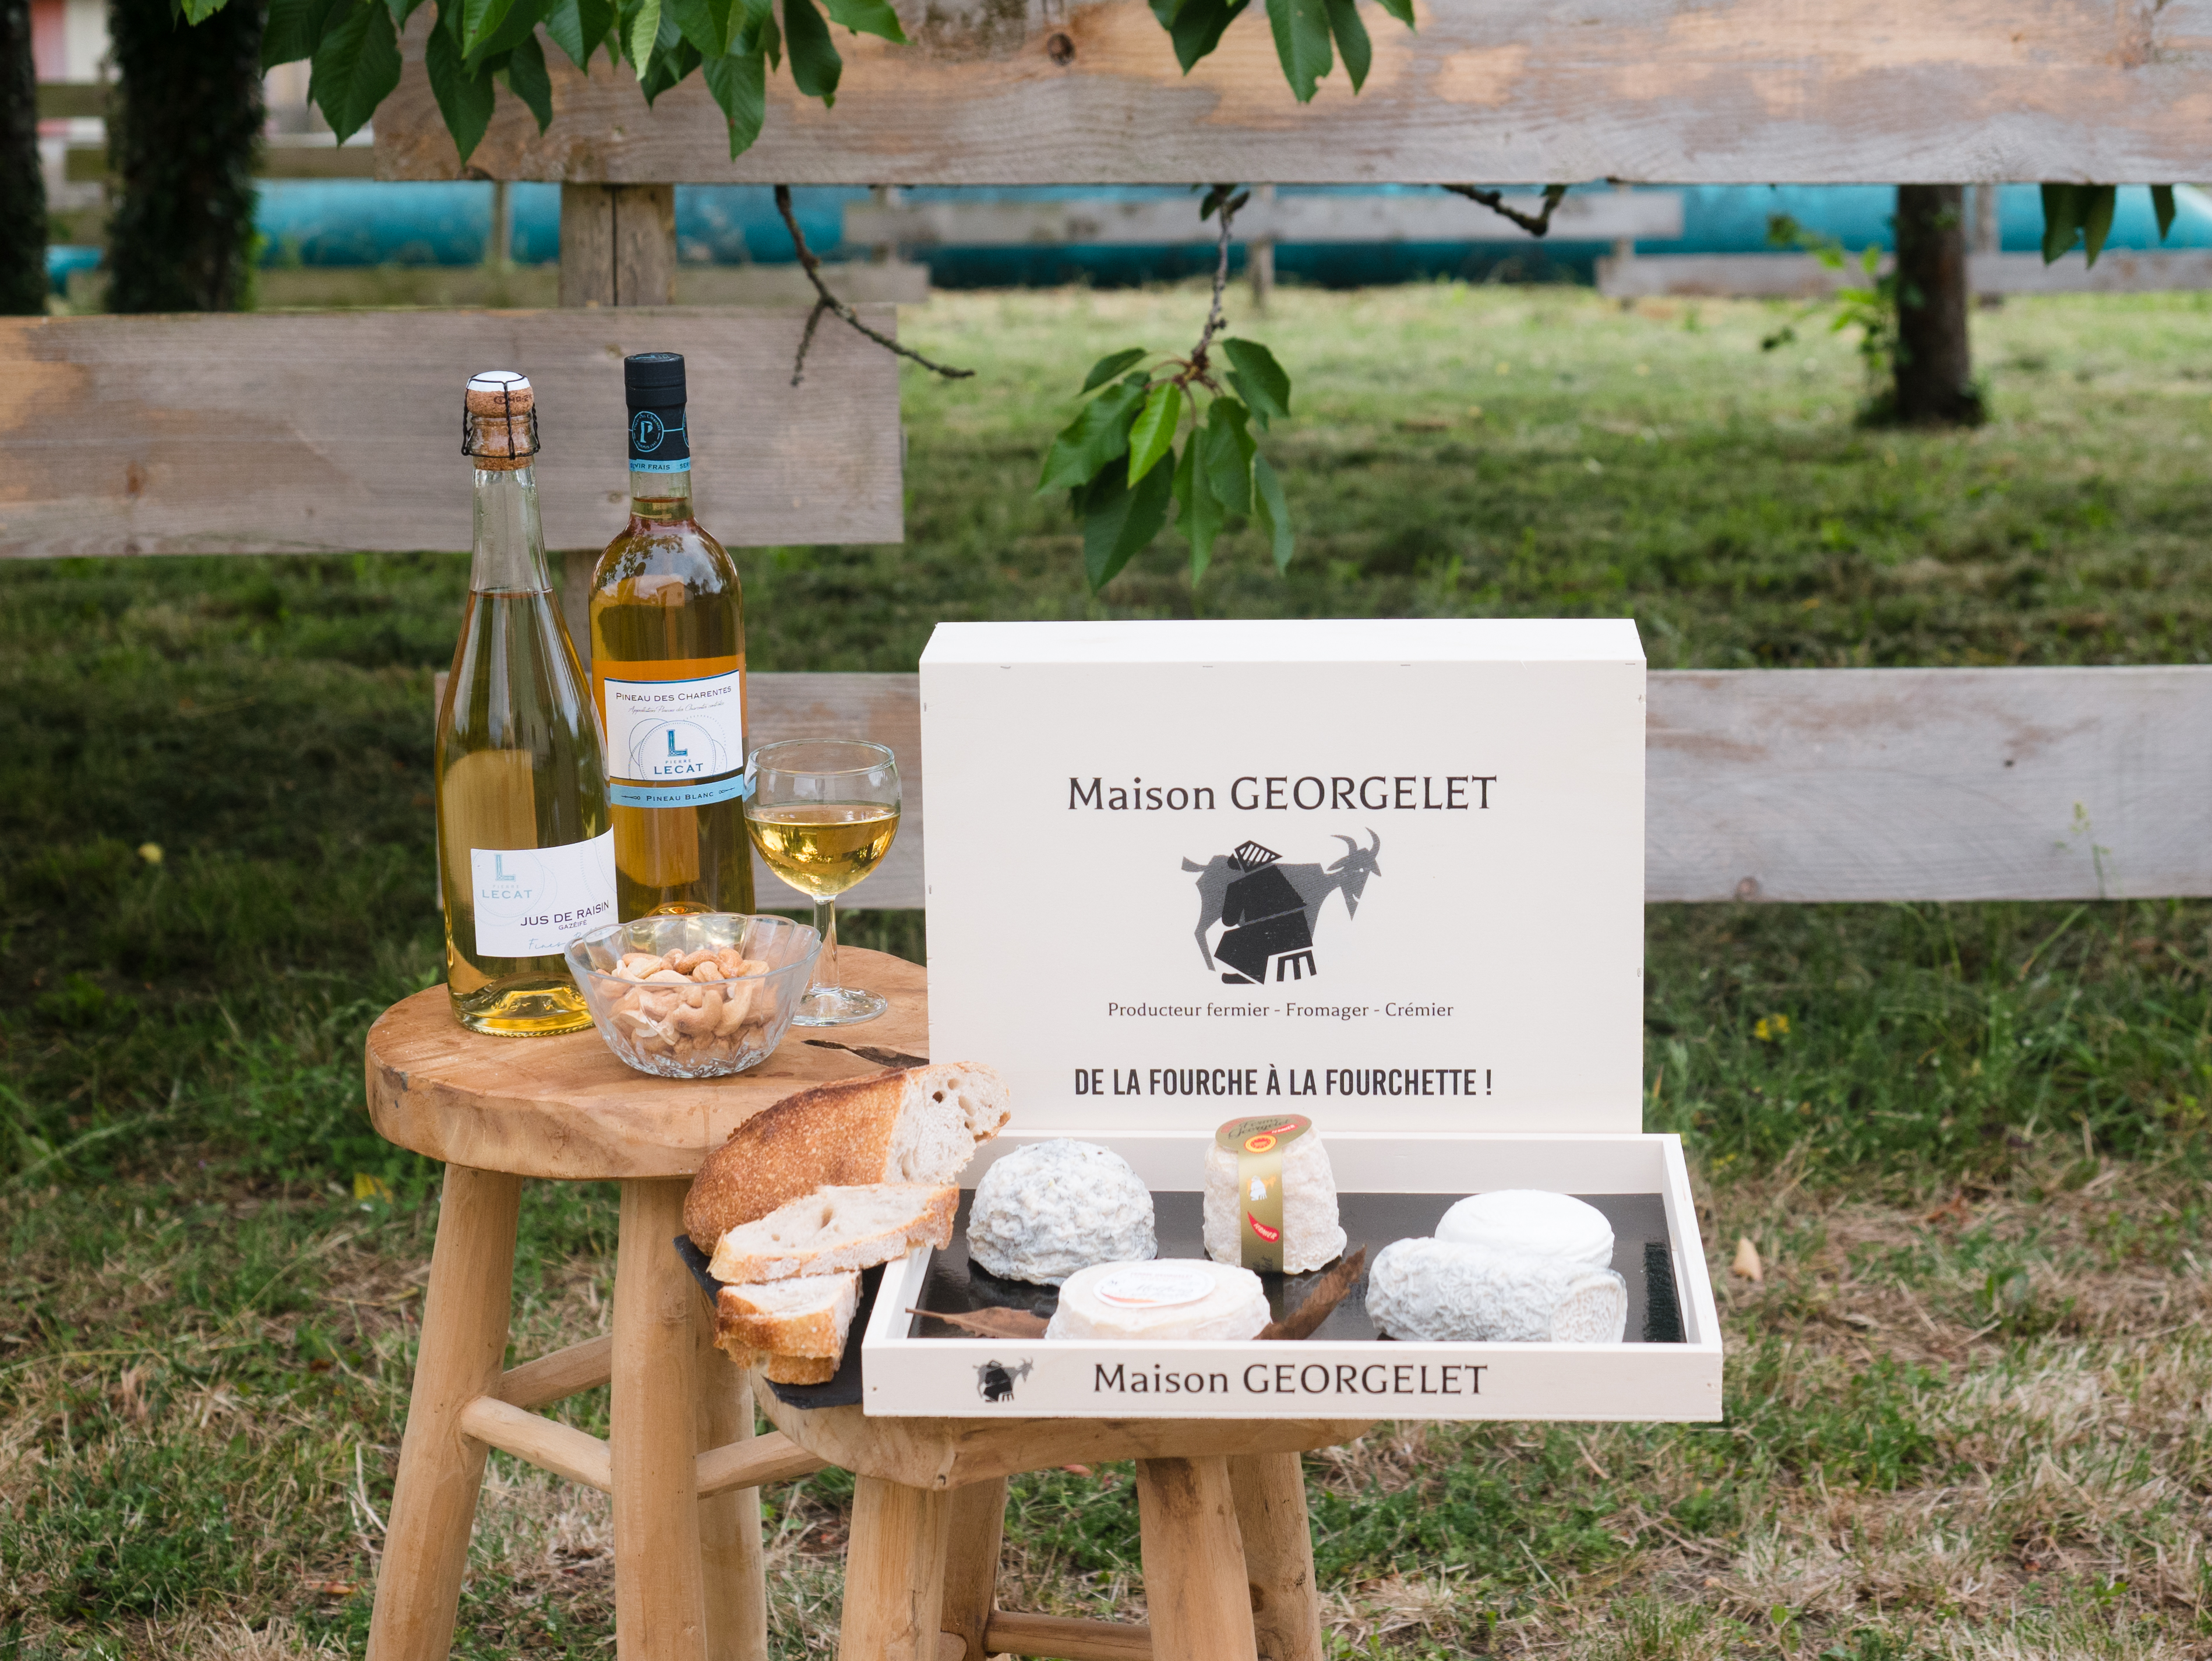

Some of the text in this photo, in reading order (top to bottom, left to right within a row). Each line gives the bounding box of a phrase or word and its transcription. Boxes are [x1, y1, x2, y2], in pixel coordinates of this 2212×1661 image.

[616, 692, 651, 701] PINEAU
[678, 686, 732, 701] CHARENTES
[666, 729, 687, 757] L
[654, 763, 703, 775] LECAT
[685, 791, 714, 800] BLANC
[1068, 775, 1497, 810] Maison GEORGELET
[495, 854, 516, 881] L
[482, 889, 532, 899] LECAT
[520, 900, 609, 926] JUS DE RAISIN
[558, 919, 587, 930] GAZÉIFÉ
[528, 938, 566, 950] Fines
[1108, 1001, 1202, 1017] Producteur
[1207, 1002, 1270, 1017] fermier
[1286, 1003, 1369, 1021] Fromager
[1385, 1002, 1454, 1017] Crémier
[1075, 1068, 1104, 1095] DE
[1113, 1068, 1141, 1095] LA
[1149, 1068, 1258, 1096] FOURCHE
[1266, 1063, 1281, 1095] À
[1290, 1068, 1317, 1095] LA
[1326, 1068, 1476, 1096] FOURCHETTE
[1094, 1363, 1488, 1395] Maison GEORGELET
